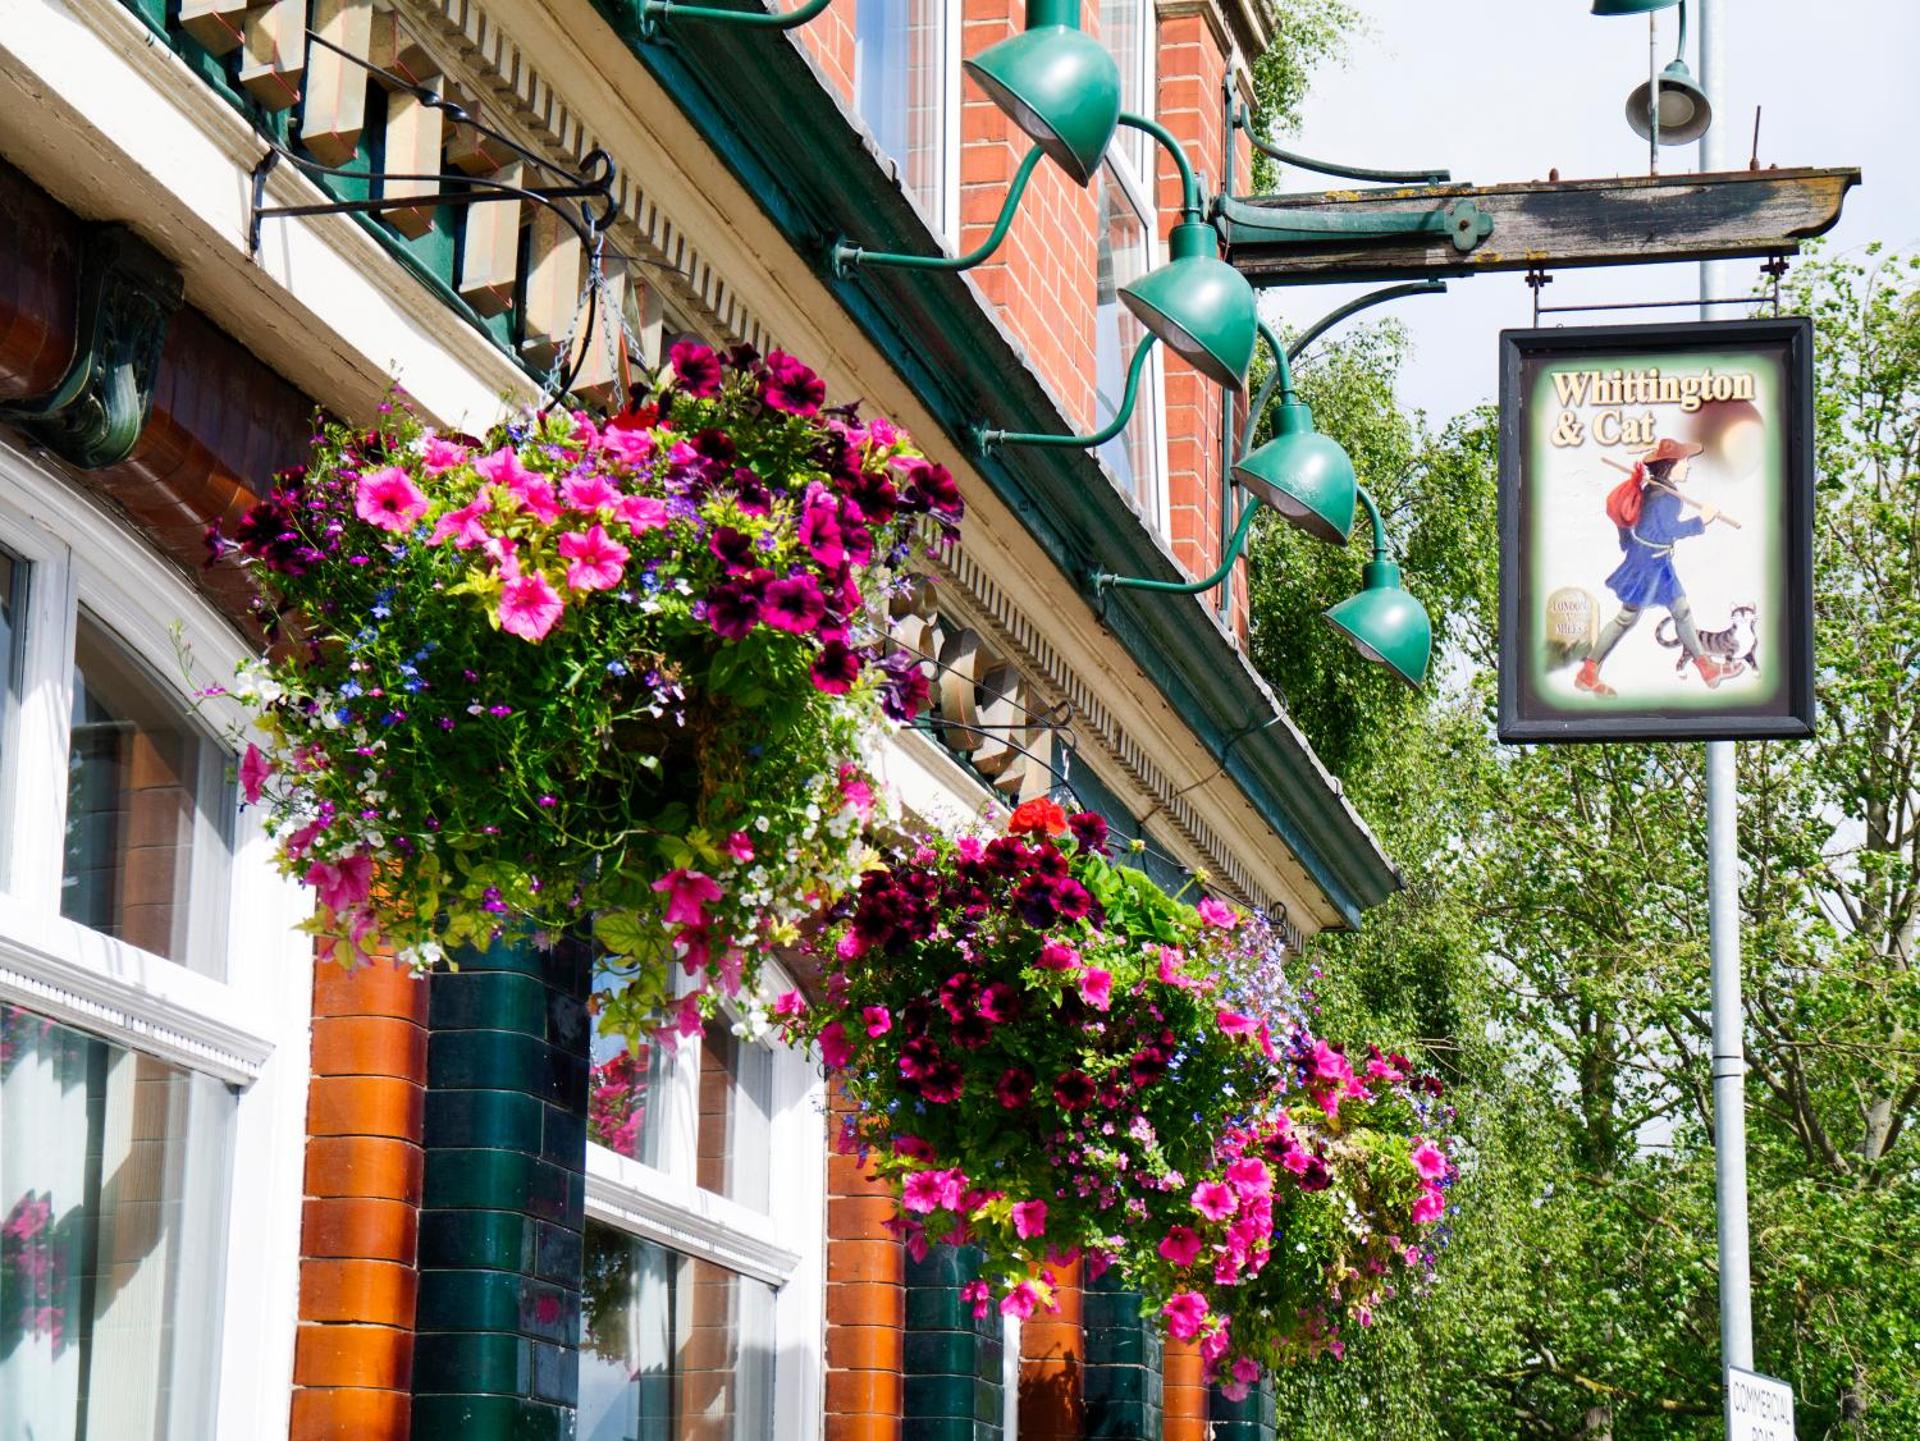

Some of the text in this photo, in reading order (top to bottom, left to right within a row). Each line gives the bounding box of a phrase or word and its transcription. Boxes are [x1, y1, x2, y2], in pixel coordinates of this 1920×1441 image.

[1551, 367, 1754, 412] Whittington
[1551, 409, 1656, 447] & Cat
[1733, 1381, 1791, 1426] COMMERCIAL
